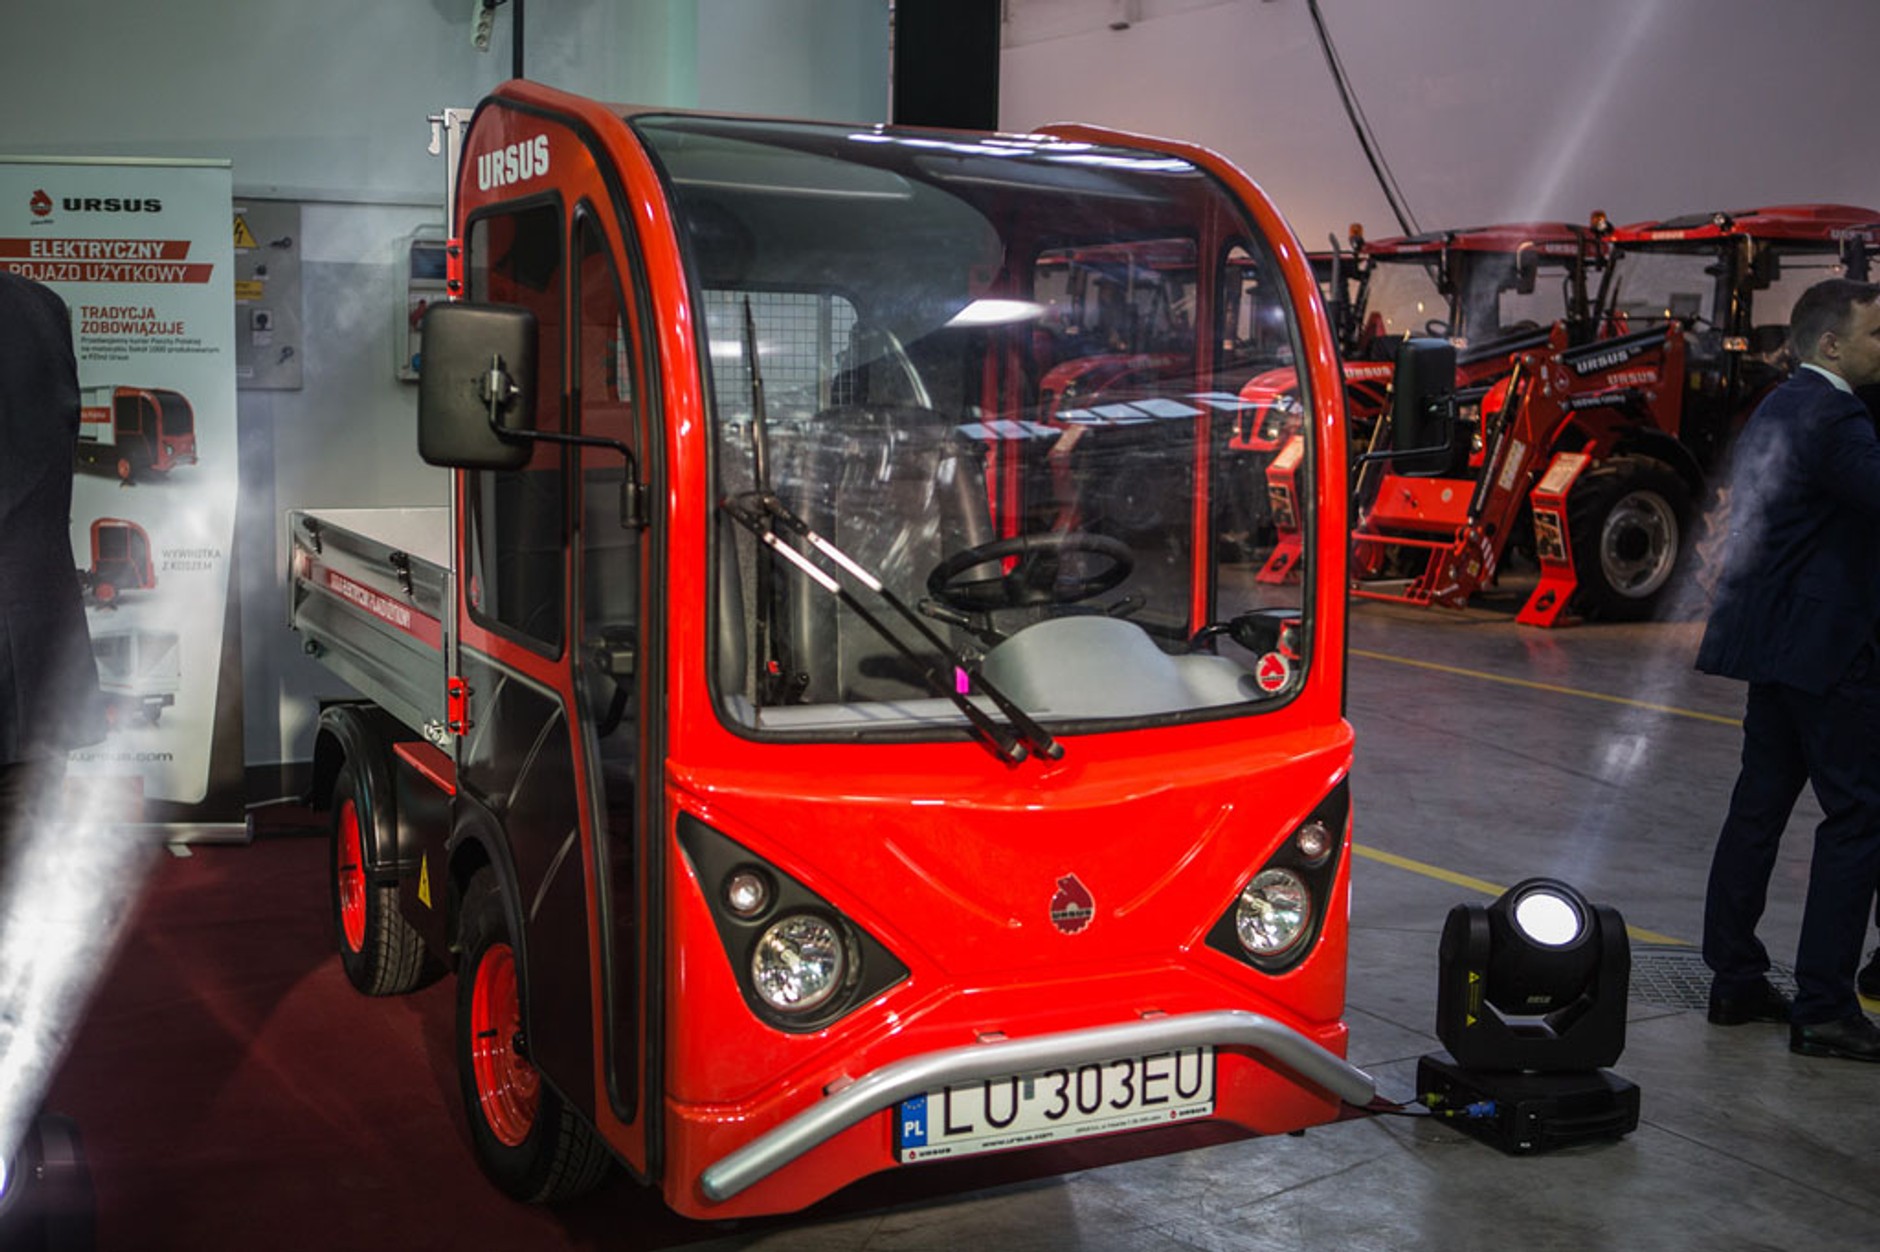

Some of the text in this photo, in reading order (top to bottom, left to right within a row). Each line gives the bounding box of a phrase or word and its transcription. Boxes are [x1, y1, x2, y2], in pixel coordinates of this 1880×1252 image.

[478, 134, 549, 191] URSUS
[63, 198, 162, 213] URSUS
[30, 240, 165, 259] ELEKTRYCZNY
[86, 261, 187, 282] UŻYTKOWY
[81, 306, 156, 319] TRADYCJA
[81, 321, 185, 336] ZOBOWIĄZUJE
[1577, 350, 1629, 374] URSUS
[1607, 369, 1657, 386] URSUS
[944, 1047, 1203, 1137] LU 303EU
[904, 1121, 924, 1137] PL
